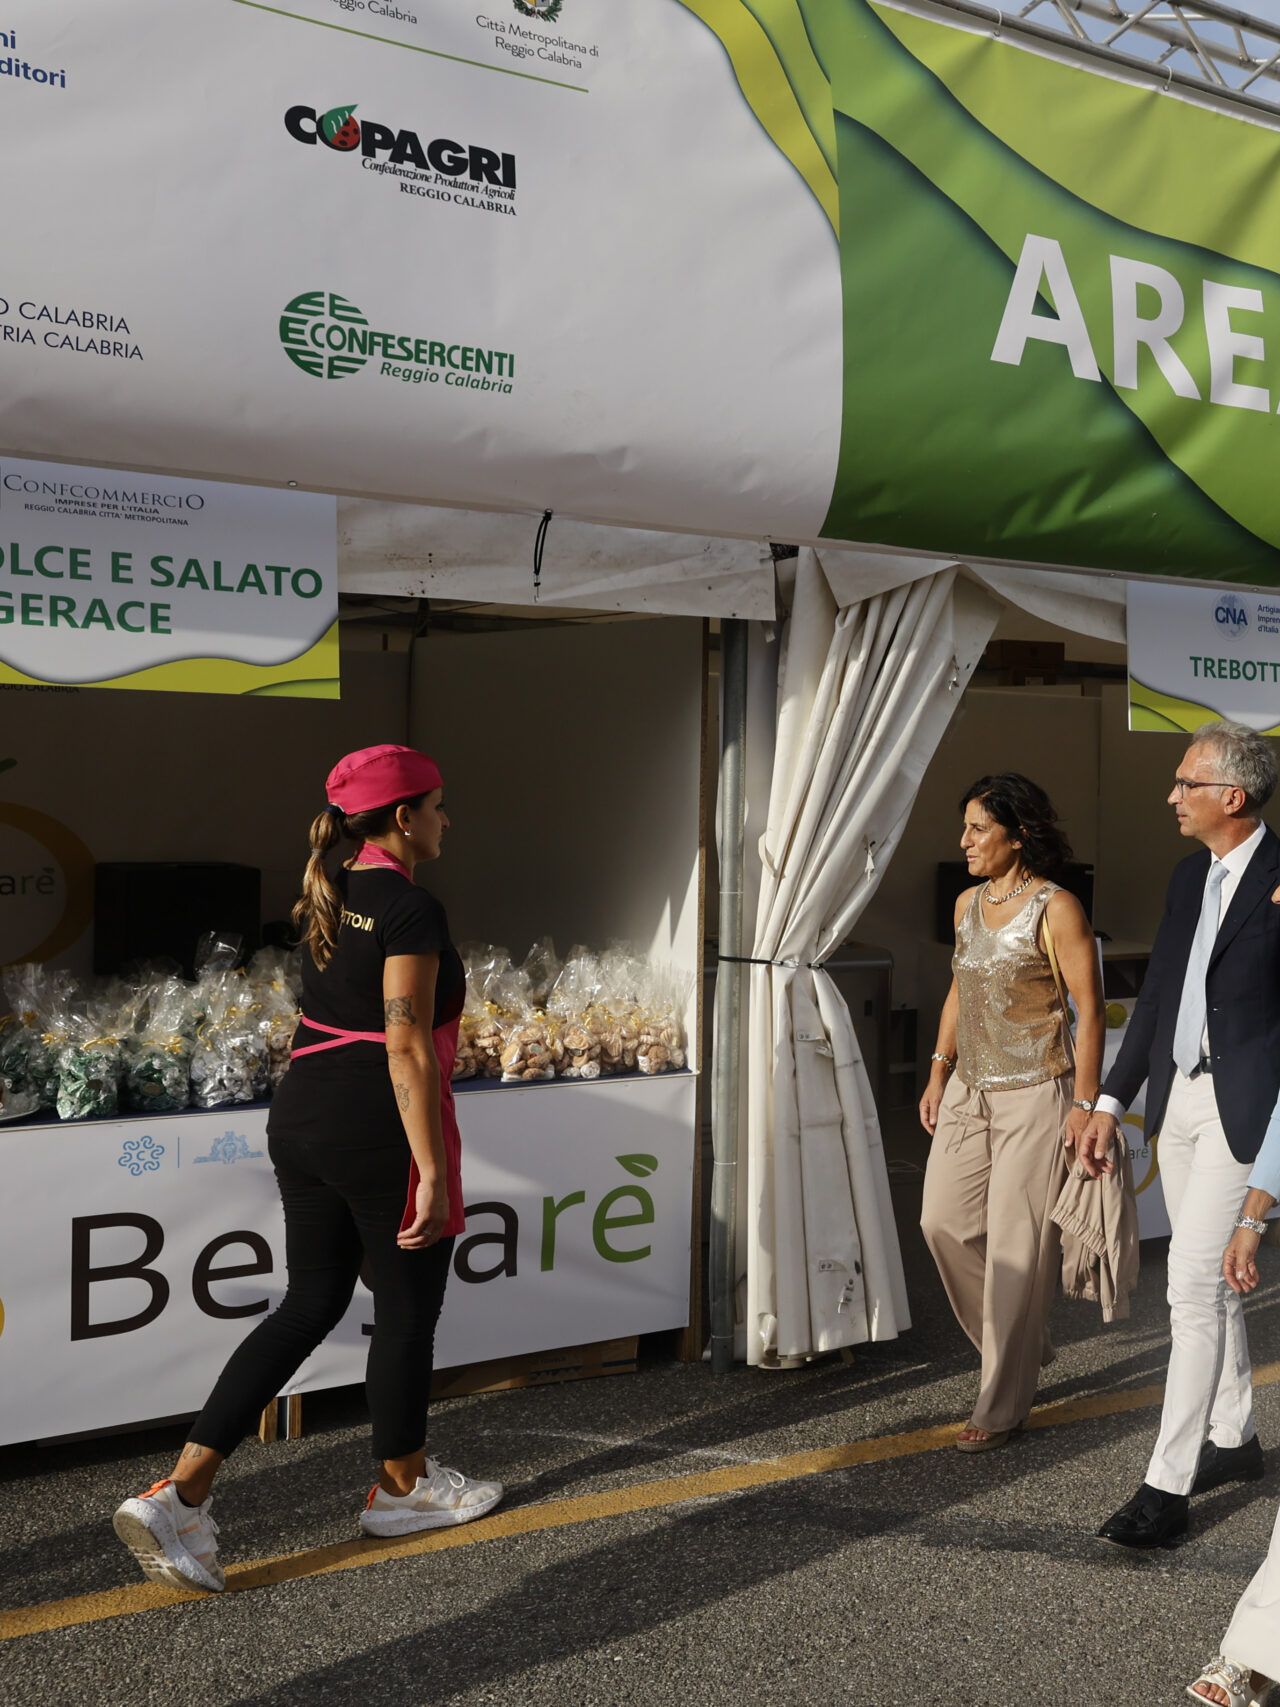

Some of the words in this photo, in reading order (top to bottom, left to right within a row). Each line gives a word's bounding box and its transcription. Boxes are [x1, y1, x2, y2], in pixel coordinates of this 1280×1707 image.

[368, 0, 418, 25] Calabria
[475, 14, 507, 34] Città
[508, 23, 588, 56] Metropolitana
[589, 44, 600, 57] di
[495, 36, 535, 59] Reggio
[536, 47, 583, 70] Calabria
[0, 57, 66, 88] ditori
[284, 104, 517, 190] COPAGRI
[361, 156, 433, 184] Confederazione
[433, 173, 481, 193] Produttori
[481, 184, 516, 202] Agricoli
[400, 181, 452, 203] REGGIO
[453, 194, 518, 217] CALABRIA
[19, 301, 131, 335] CALABRIA
[44, 331, 144, 361] CALABRIA
[380, 361, 440, 384] Reggio
[444, 371, 513, 395] Calabria
[3, 474, 205, 511] CONFCOMMERCIO
[54, 497, 98, 509] IMPRESE
[100, 502, 119, 511] PER
[121, 505, 160, 515] L'ITALIA
[24, 502, 56, 513] REGGIO
[57, 506, 97, 517] CALABRIA
[99, 511, 123, 520] CITTA'
[124, 513, 189, 526] METROPOLITANA
[0, 542, 93, 581] LCE
[111, 551, 134, 585] E
[150, 554, 323, 599] SALATO
[1215, 606, 1248, 626] CNA
[1257, 625, 1279, 634] d'Italia
[70, 1153, 659, 1341] Bearè
